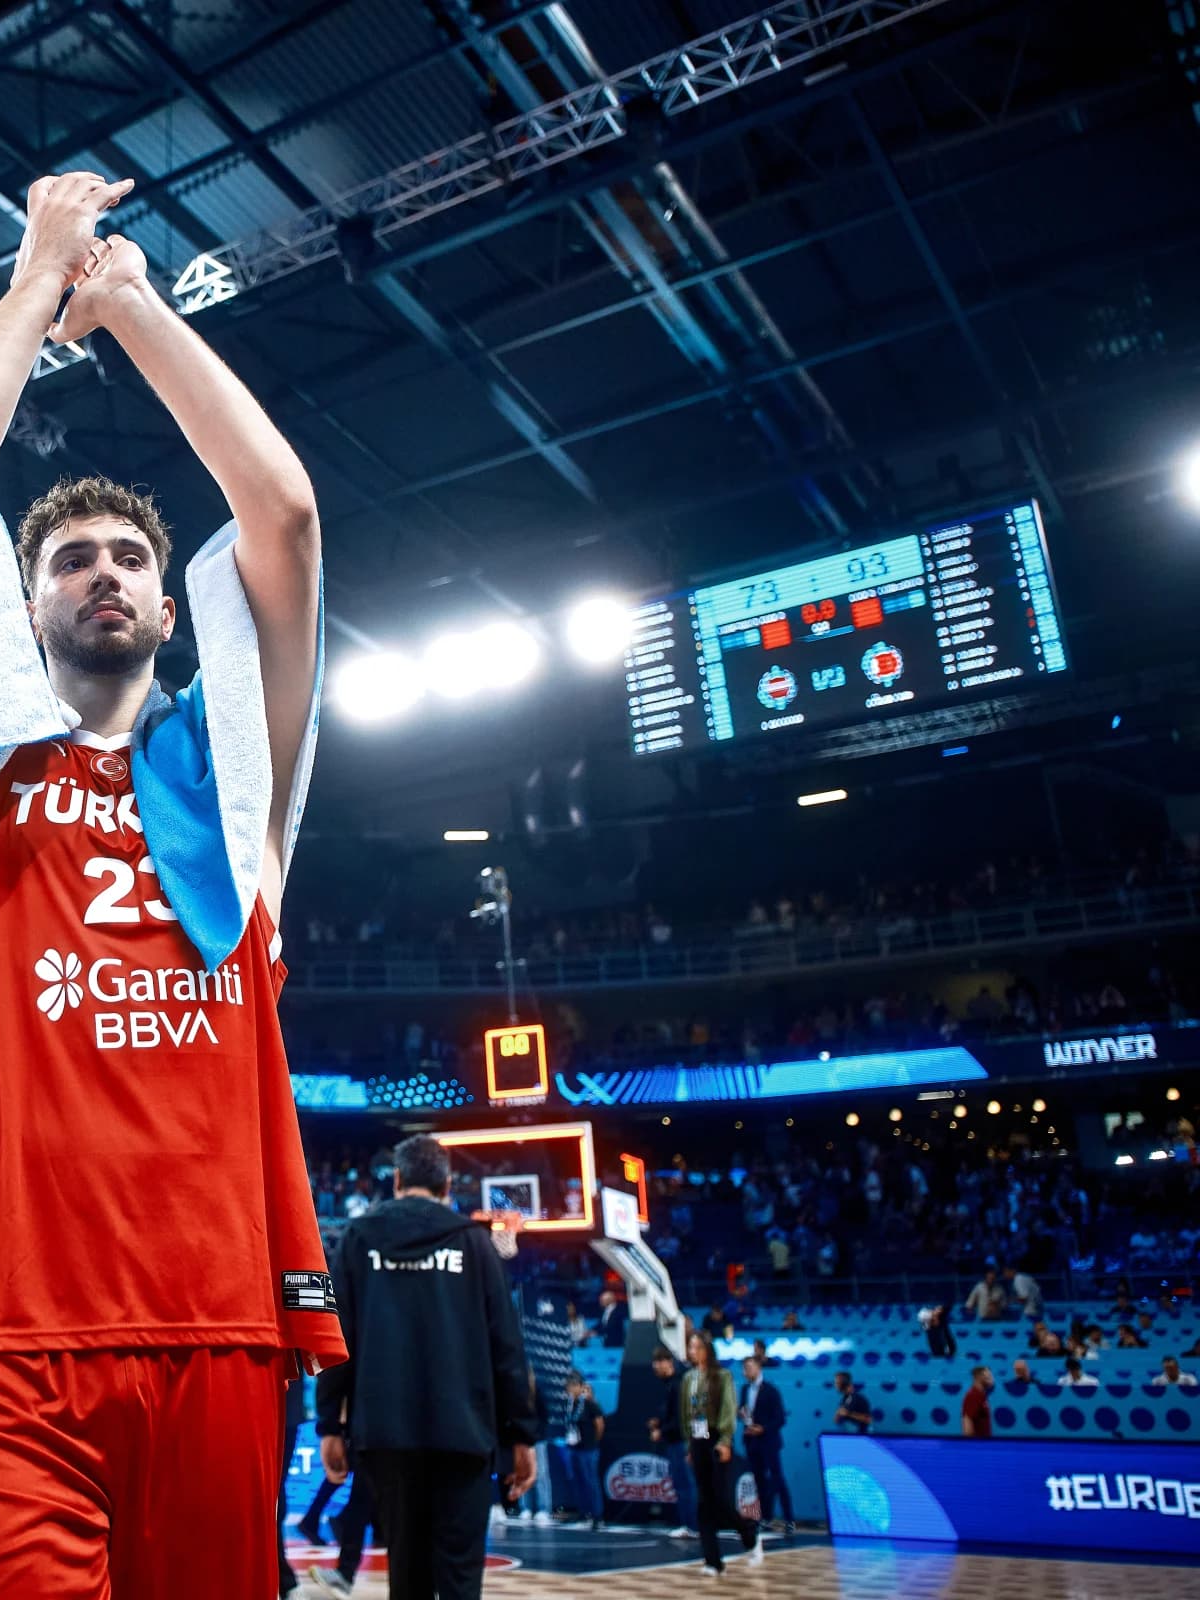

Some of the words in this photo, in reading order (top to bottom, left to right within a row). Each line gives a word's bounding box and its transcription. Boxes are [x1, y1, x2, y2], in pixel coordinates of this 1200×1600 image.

[739, 580, 781, 608] 73
[847, 552, 889, 582] 93
[10, 776, 144, 837] TÜRK
[87, 958, 244, 1006] Garanti
[94, 1007, 220, 1050] BBVA
[1043, 1033, 1158, 1067] WINNER
[285, 1274, 309, 1285] PUMA
